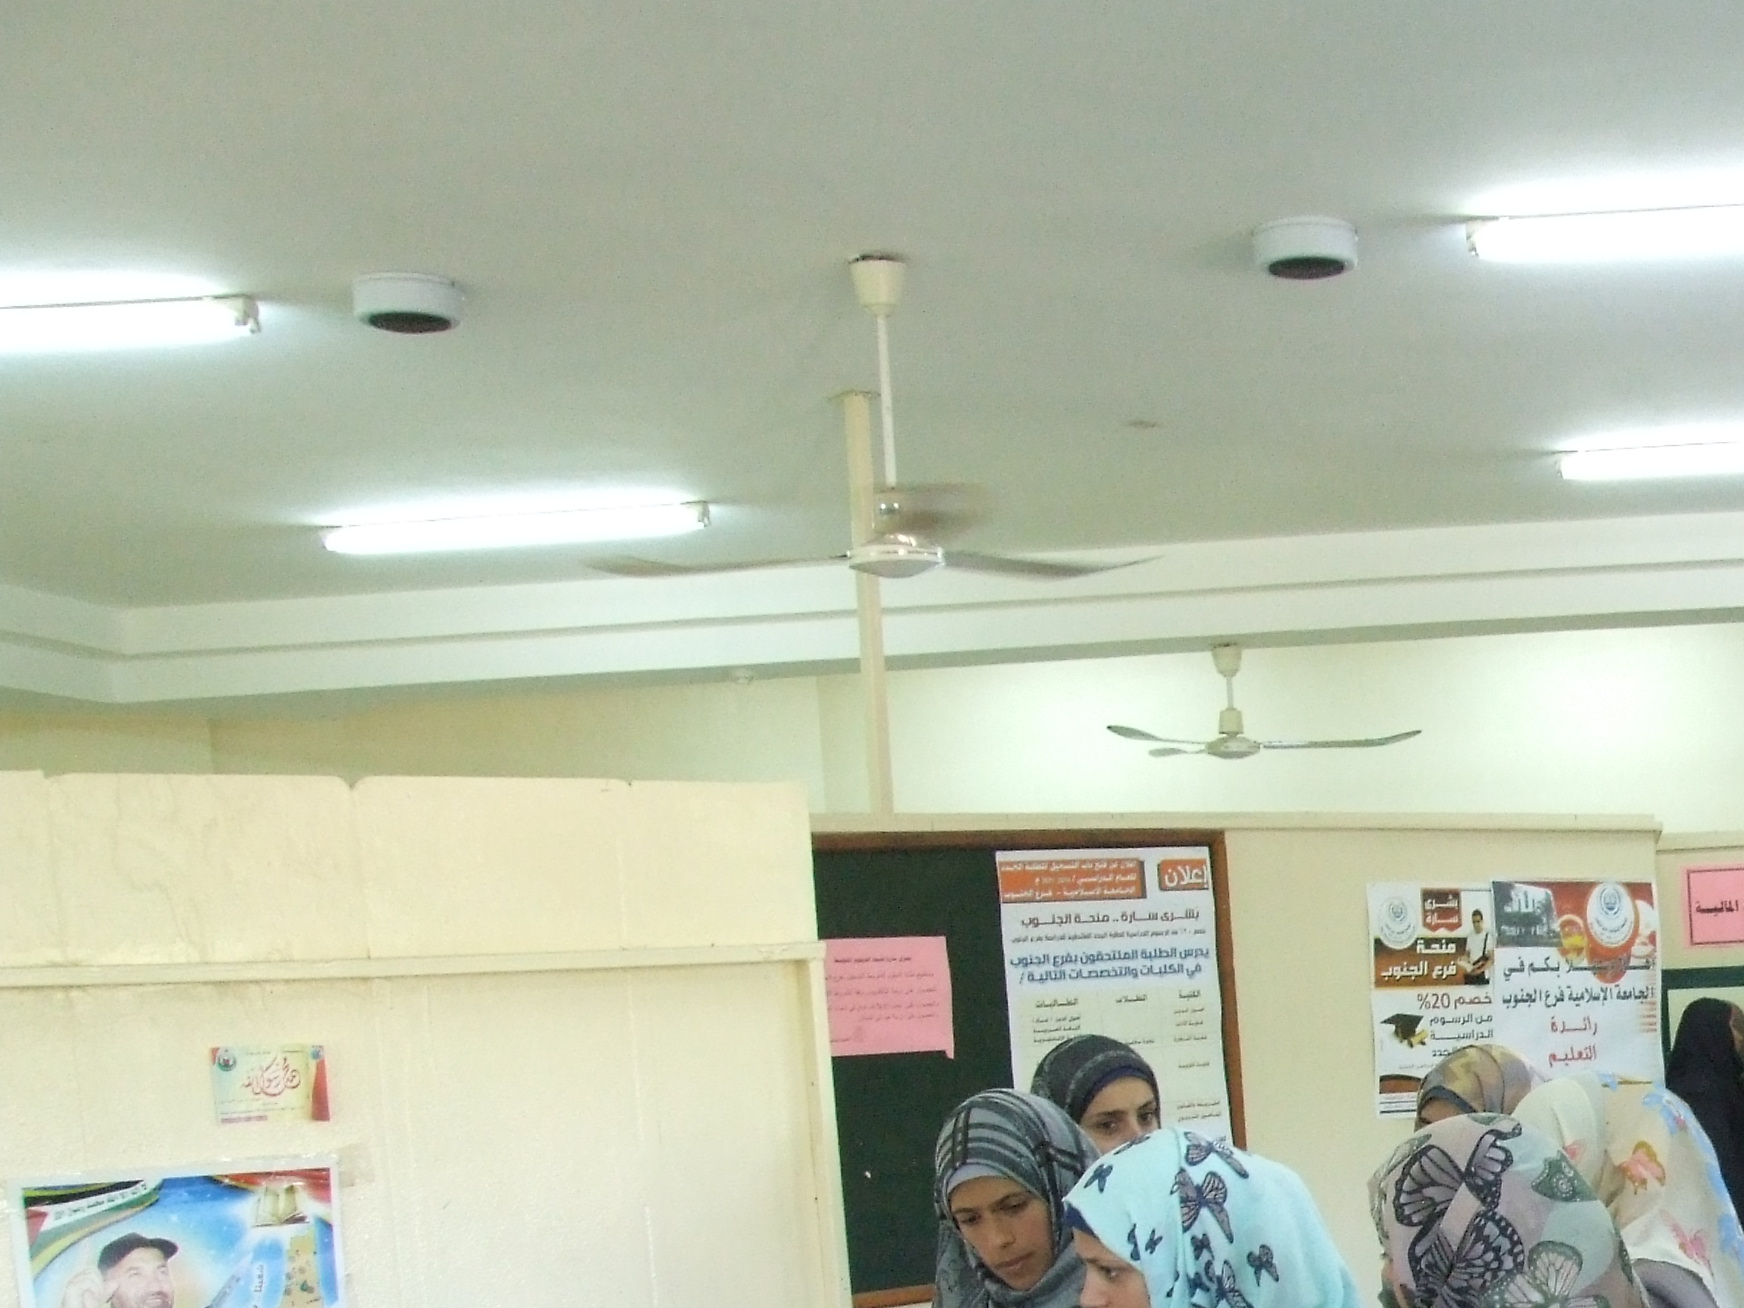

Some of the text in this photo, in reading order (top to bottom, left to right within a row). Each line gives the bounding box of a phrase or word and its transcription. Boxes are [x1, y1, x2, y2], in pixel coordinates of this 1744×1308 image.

[1165, 863, 1209, 888] إعلان
[1695, 899, 1739, 917] المالية
[1021, 911, 1072, 929] الجنوب
[1424, 912, 1459, 925] سارة
[1140, 946, 1177, 960] الطلبة
[1416, 938, 1456, 955] منحة
[1010, 953, 1050, 967] الجنوب
[1503, 955, 1525, 981] في
[1528, 956, 1561, 978] بكم
[1027, 968, 1066, 983] التالية
[1140, 963, 1184, 976] الكليات
[1186, 963, 1202, 978] في
[1380, 960, 1457, 981] فرع الجنوب
[1453, 992, 1493, 1011] خصم
[1502, 984, 1654, 1009] الجامعة الإسلامية فرع الجنوب
[1429, 1012, 1493, 1027] من الرسوم
[1429, 1029, 1494, 1041] الدراسية
[1548, 1045, 1597, 1068] التعليم
